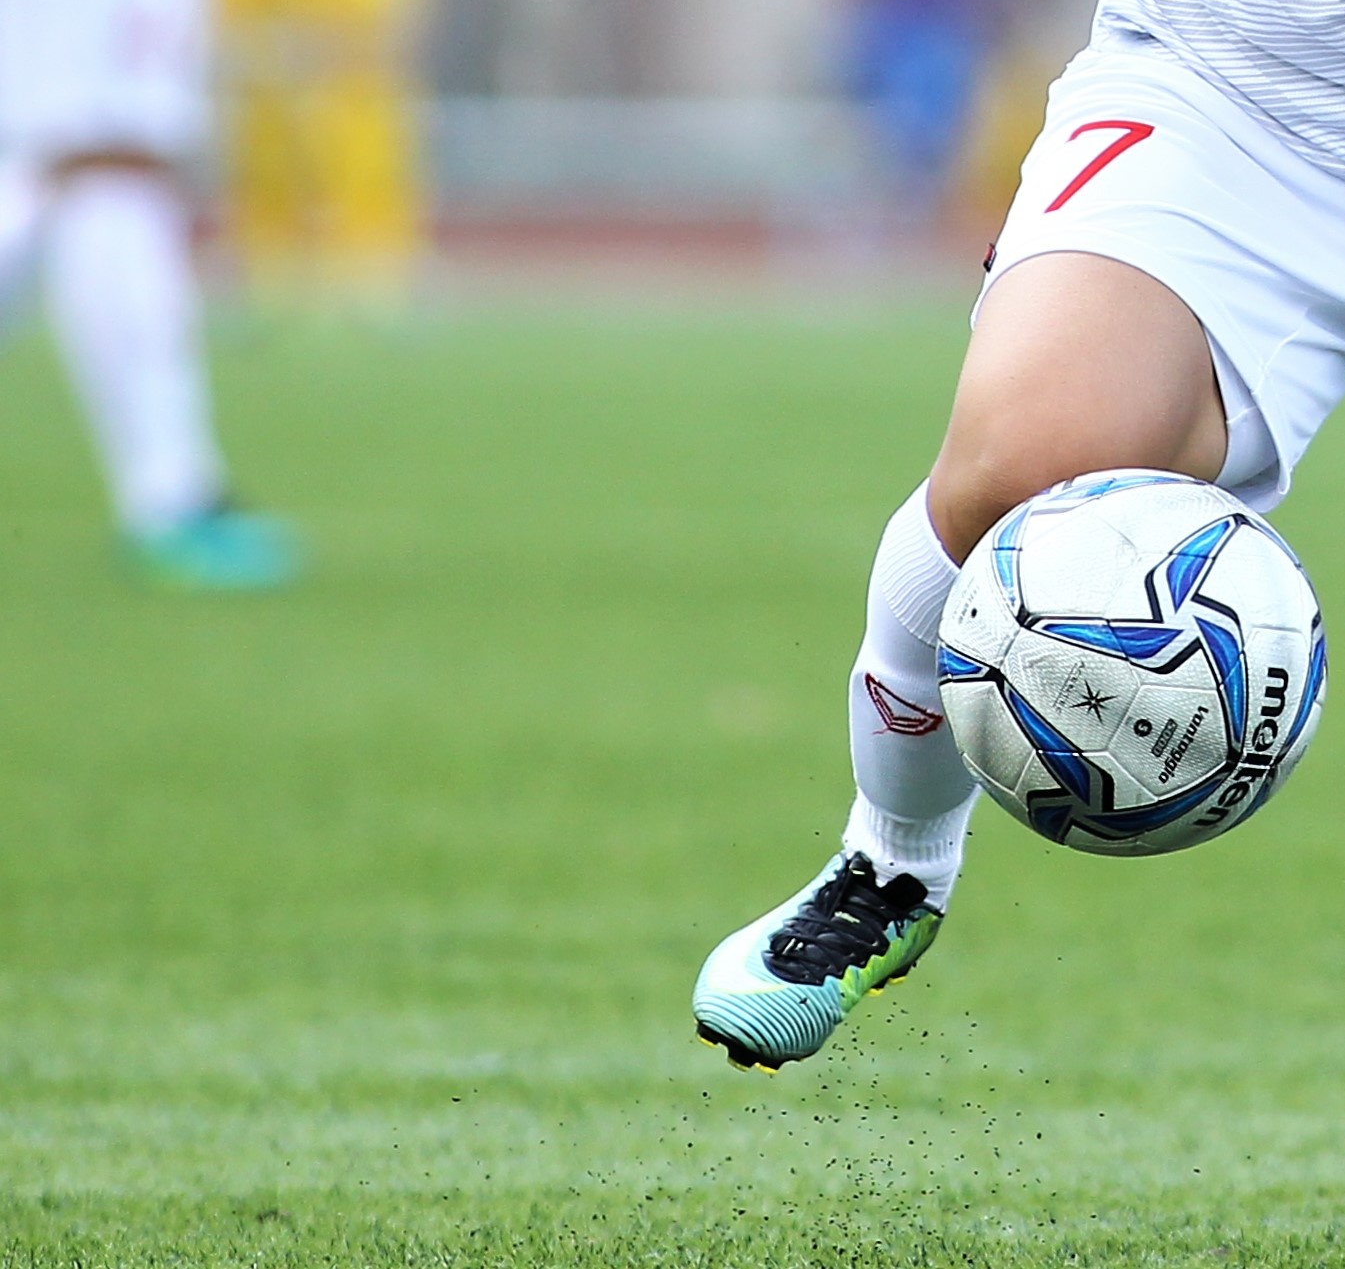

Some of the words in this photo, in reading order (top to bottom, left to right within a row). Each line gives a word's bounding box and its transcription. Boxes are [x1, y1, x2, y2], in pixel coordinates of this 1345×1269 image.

[1044, 119, 1155, 214] 7
[1158, 705, 1209, 784] vantaggio
[1193, 667, 1289, 826] molten
